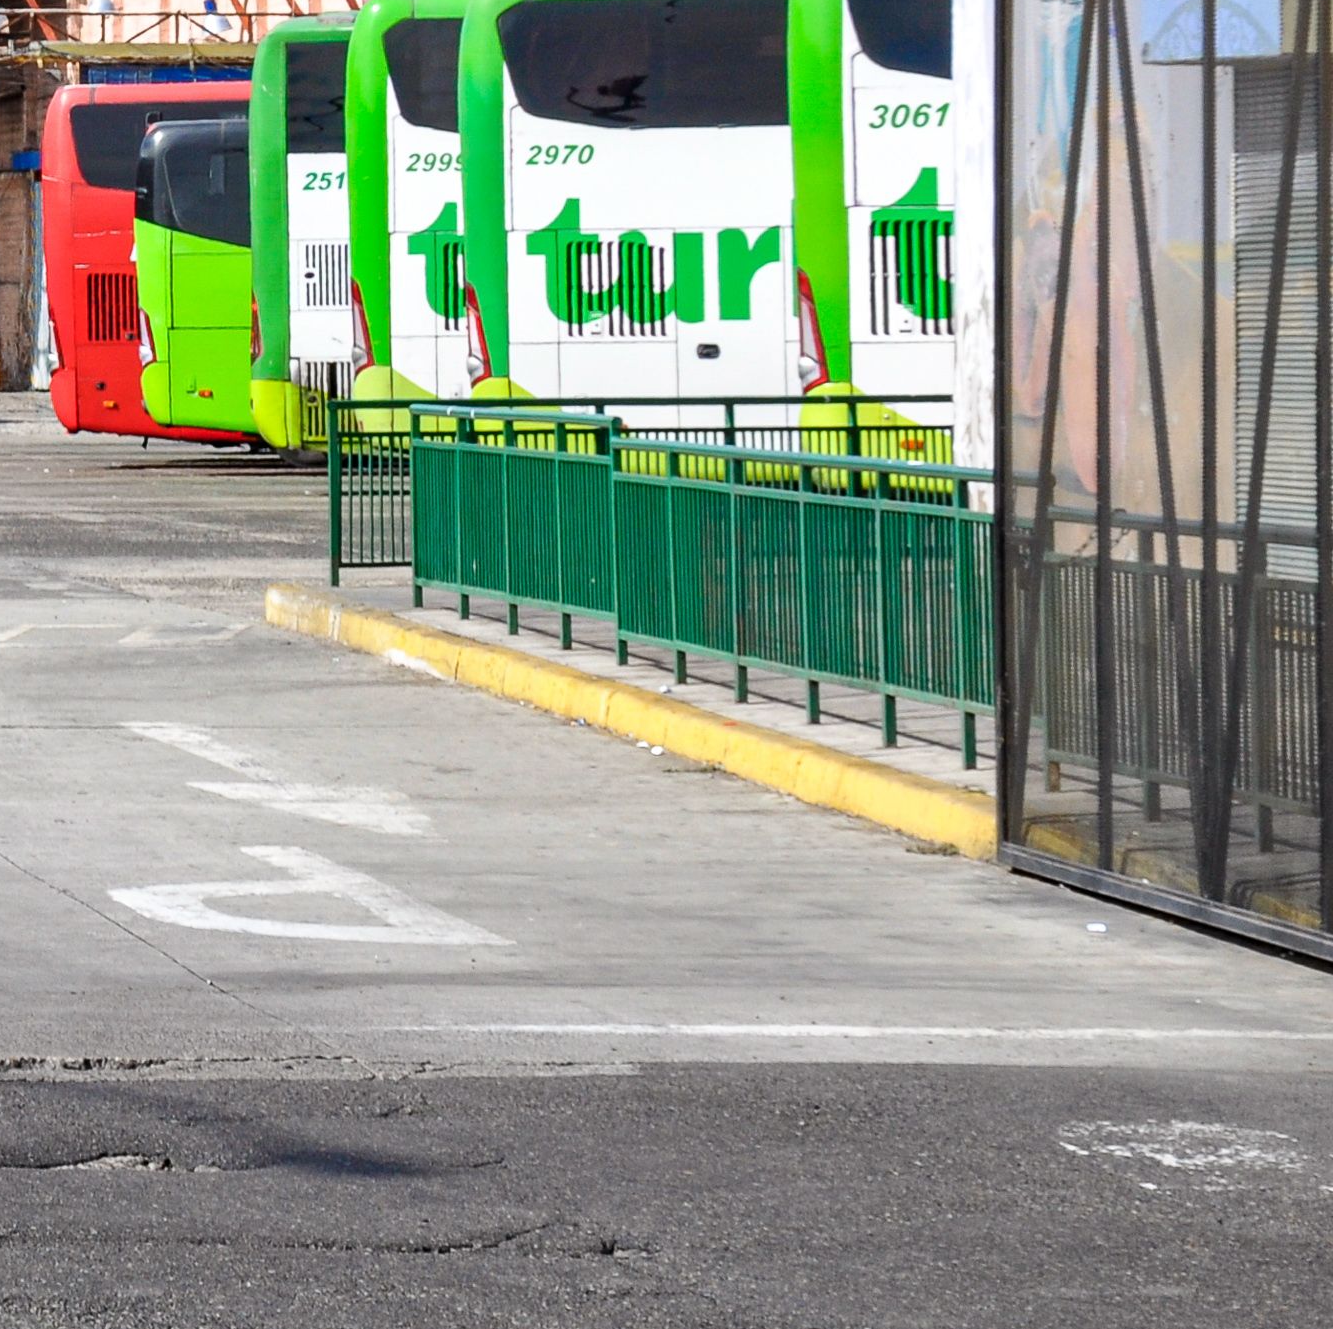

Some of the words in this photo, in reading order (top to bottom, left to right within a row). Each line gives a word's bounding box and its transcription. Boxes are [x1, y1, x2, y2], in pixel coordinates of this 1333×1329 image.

[869, 102, 951, 129] 3061
[525, 144, 595, 166] 2970
[302, 172, 346, 191] 251
[525, 198, 782, 324] tur
